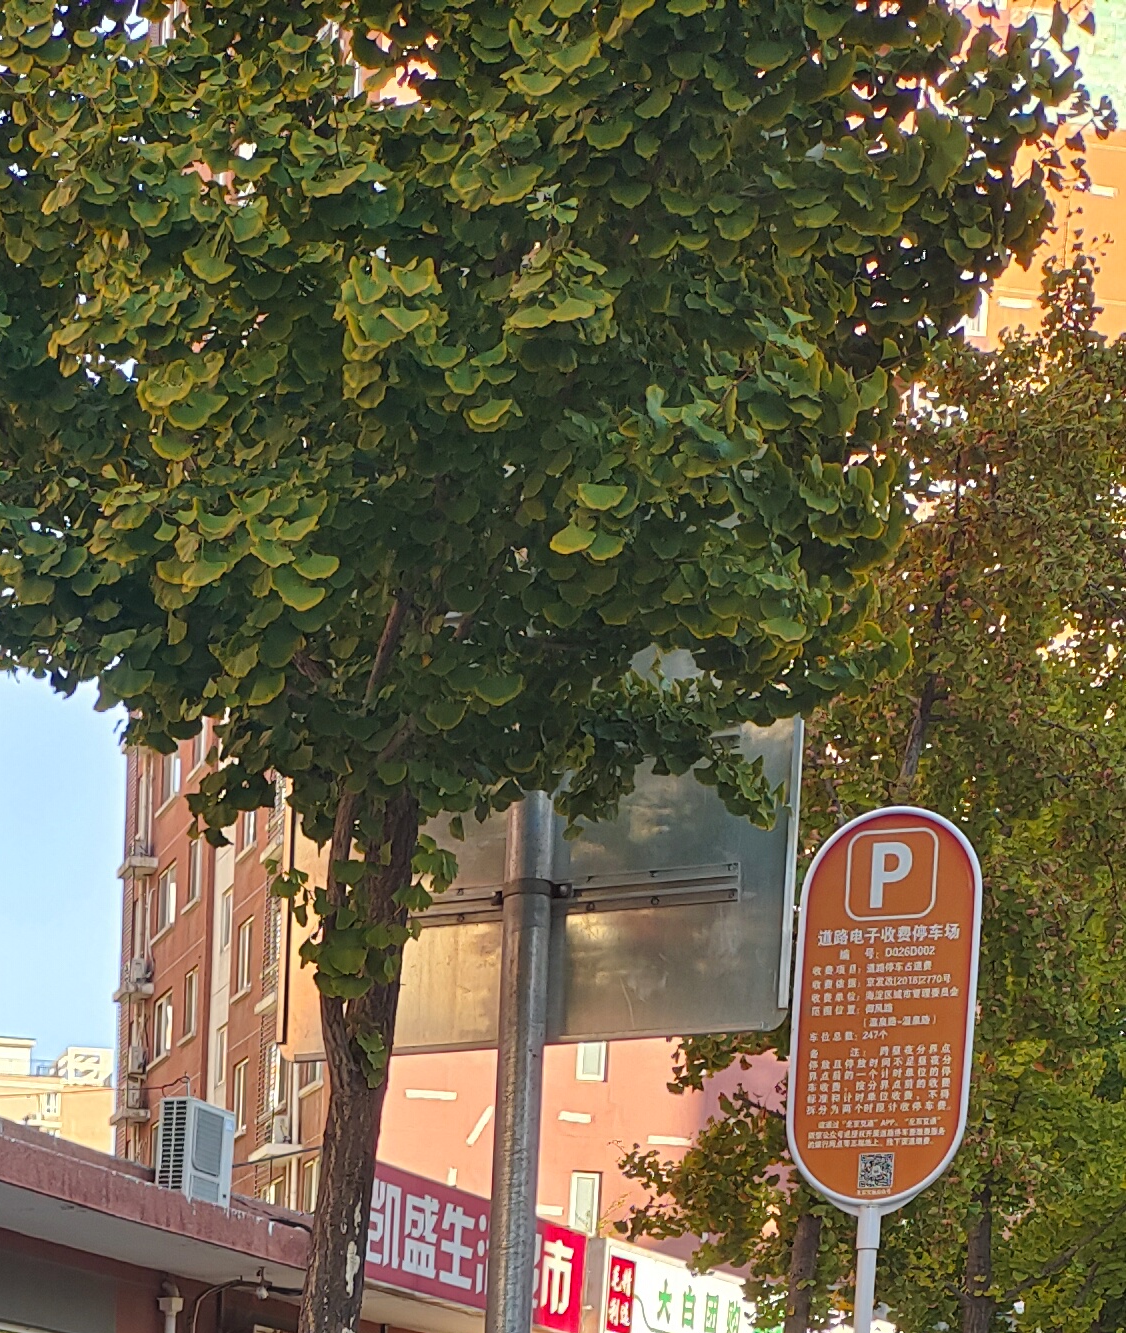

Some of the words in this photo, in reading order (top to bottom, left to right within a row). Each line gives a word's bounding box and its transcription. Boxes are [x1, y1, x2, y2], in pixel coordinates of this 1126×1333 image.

[868, 841, 913, 909] P
[817, 923, 960, 946] 道路电子收费停车场
[365, 1178, 575, 1316] 凯盛生市
